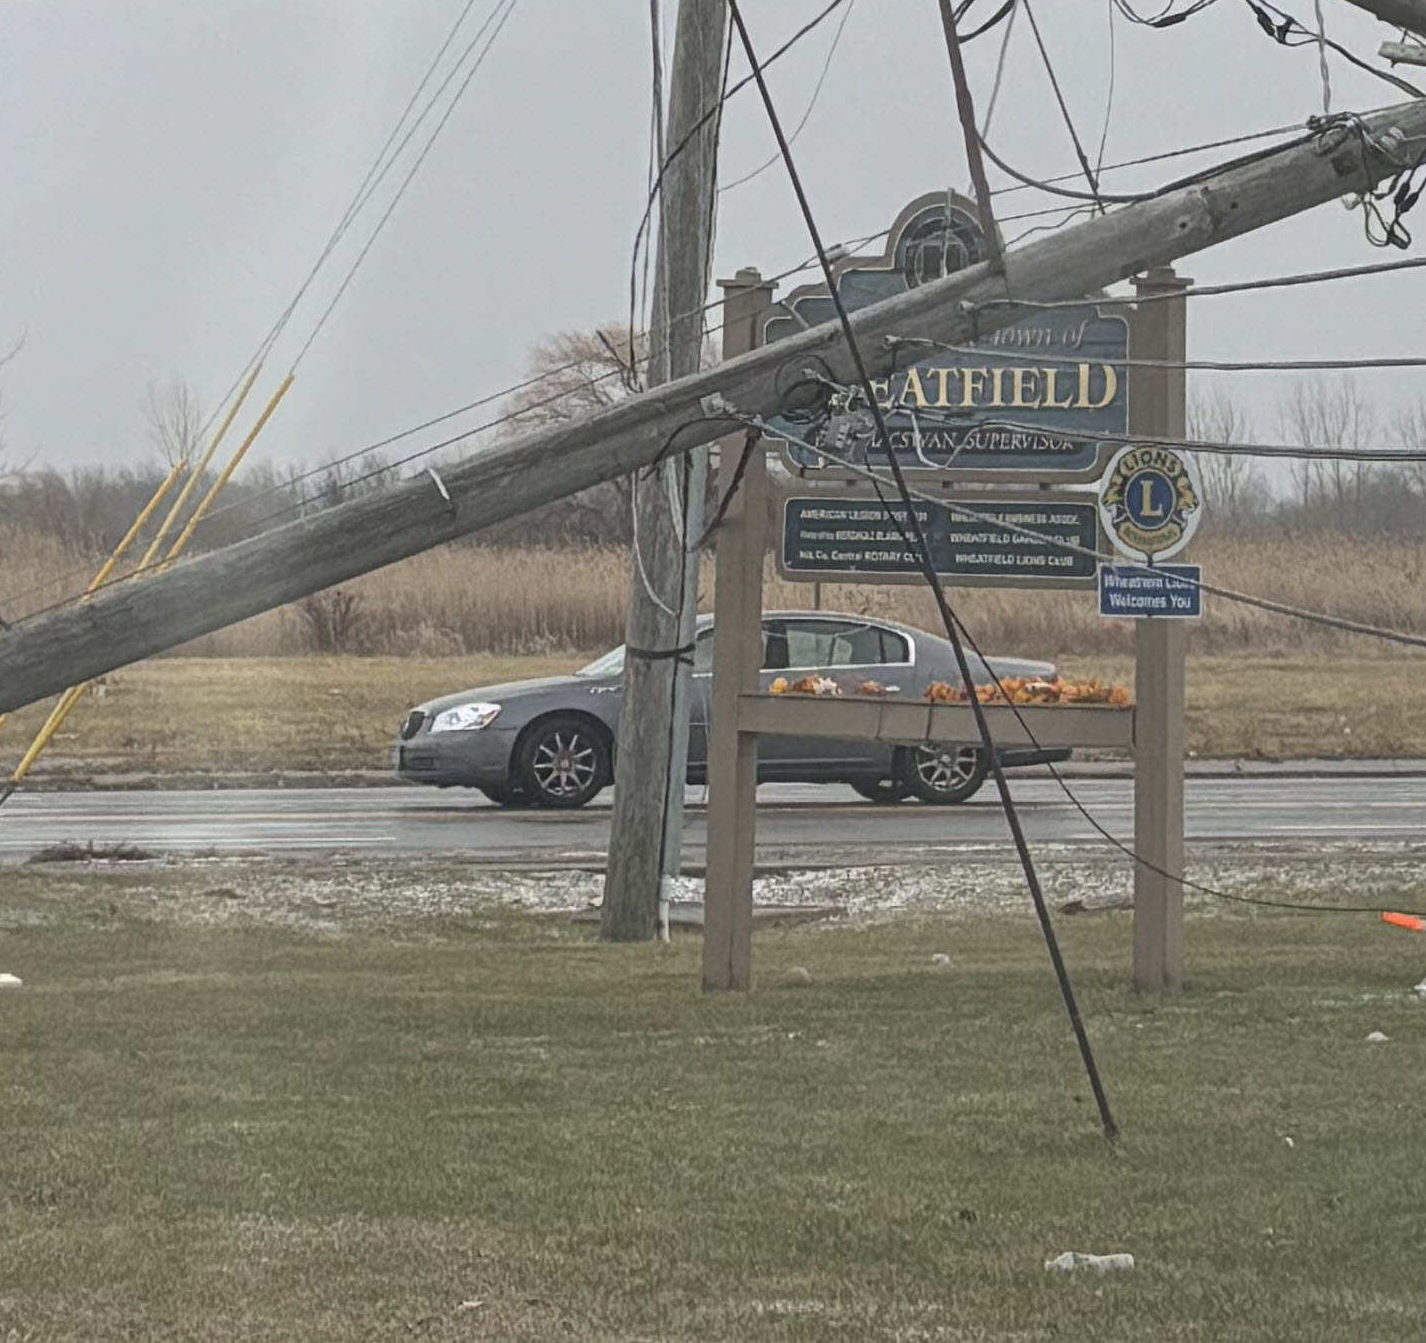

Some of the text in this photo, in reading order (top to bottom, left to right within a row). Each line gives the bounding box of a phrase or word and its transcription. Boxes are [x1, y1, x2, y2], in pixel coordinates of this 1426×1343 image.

[869, 363, 1117, 409] EATFIELD
[1124, 449, 1178, 473] LIONS
[1139, 479, 1163, 517] L
[1109, 593, 1192, 609] Welcomes You
